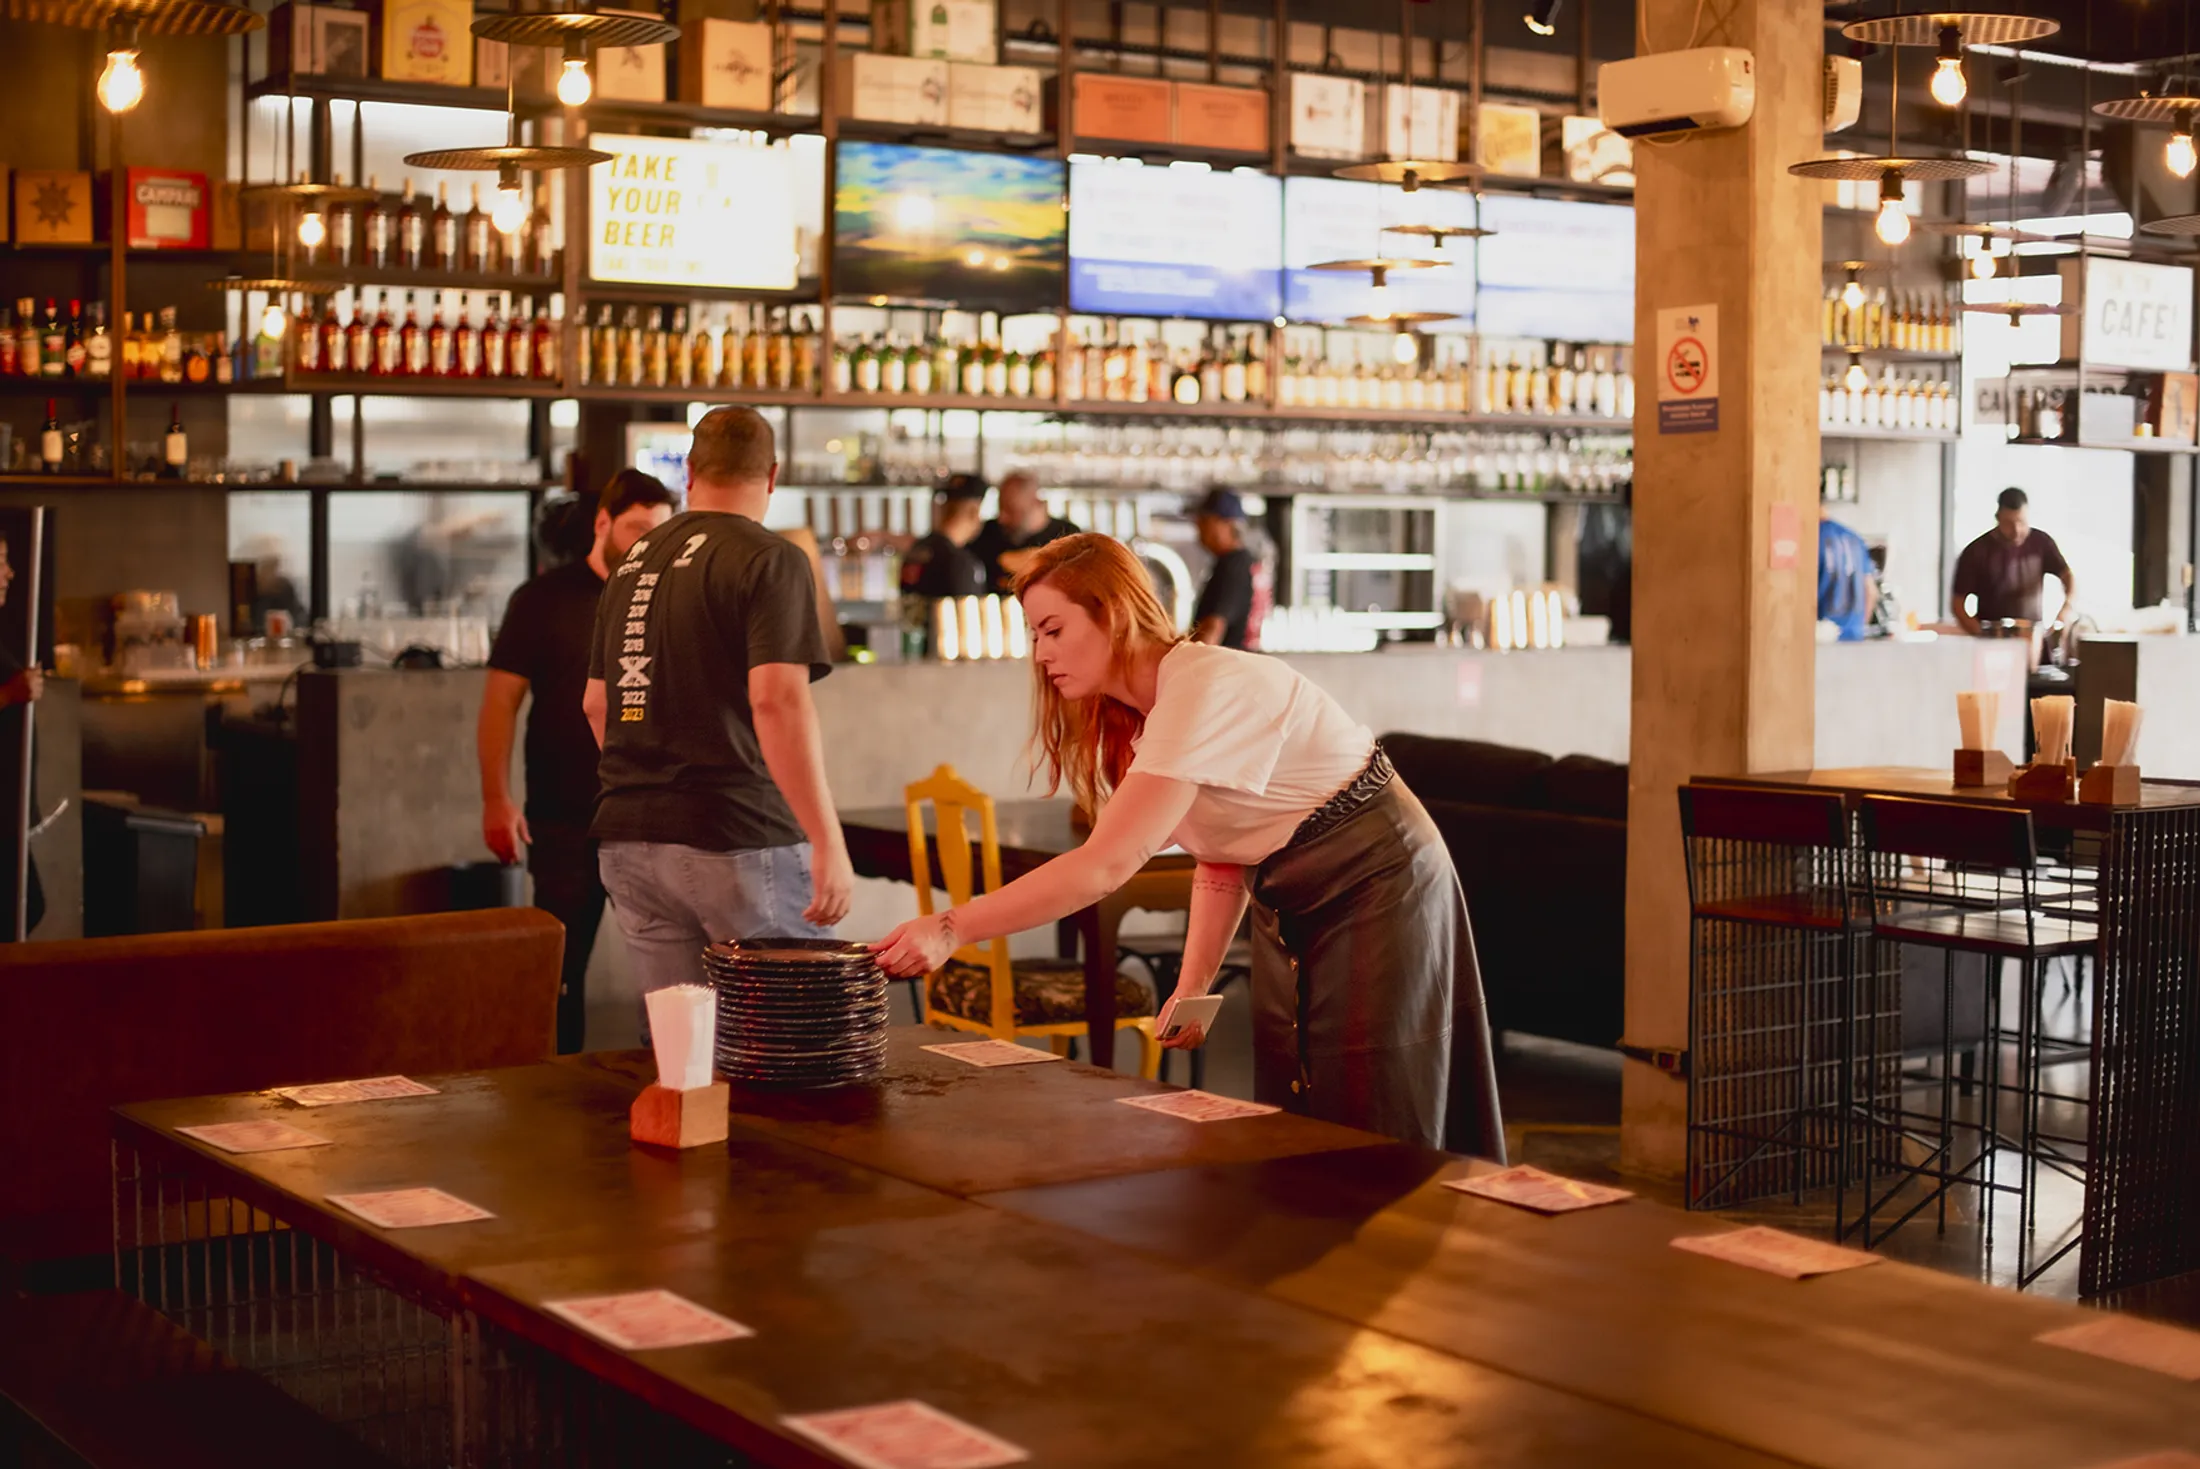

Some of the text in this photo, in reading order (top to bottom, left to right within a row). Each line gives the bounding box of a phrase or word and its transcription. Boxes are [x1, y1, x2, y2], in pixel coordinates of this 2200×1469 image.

[609, 152, 679, 182] TAKE
[607, 185, 682, 214] YOUR
[603, 220, 676, 248] BEER
[621, 690, 647, 706] 2022
[620, 707, 645, 722] 2023
